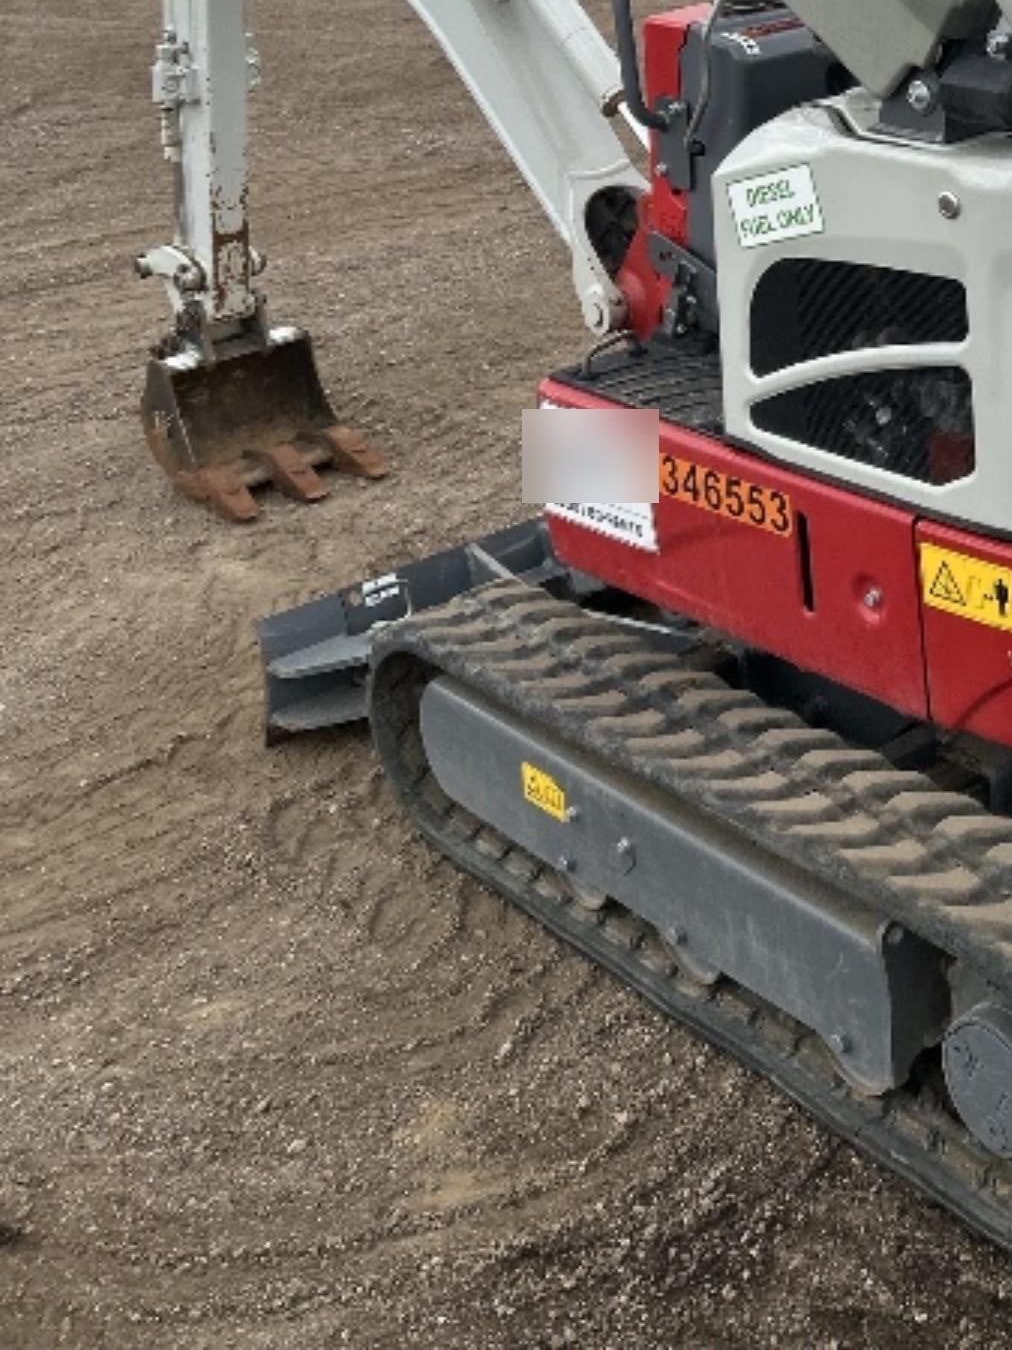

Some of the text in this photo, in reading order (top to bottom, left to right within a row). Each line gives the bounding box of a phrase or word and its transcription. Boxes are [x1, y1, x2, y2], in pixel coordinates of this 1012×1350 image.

[745, 179, 796, 208] DIESEL
[739, 203, 815, 238] FUEL ONLY
[661, 454, 791, 534] 346553
